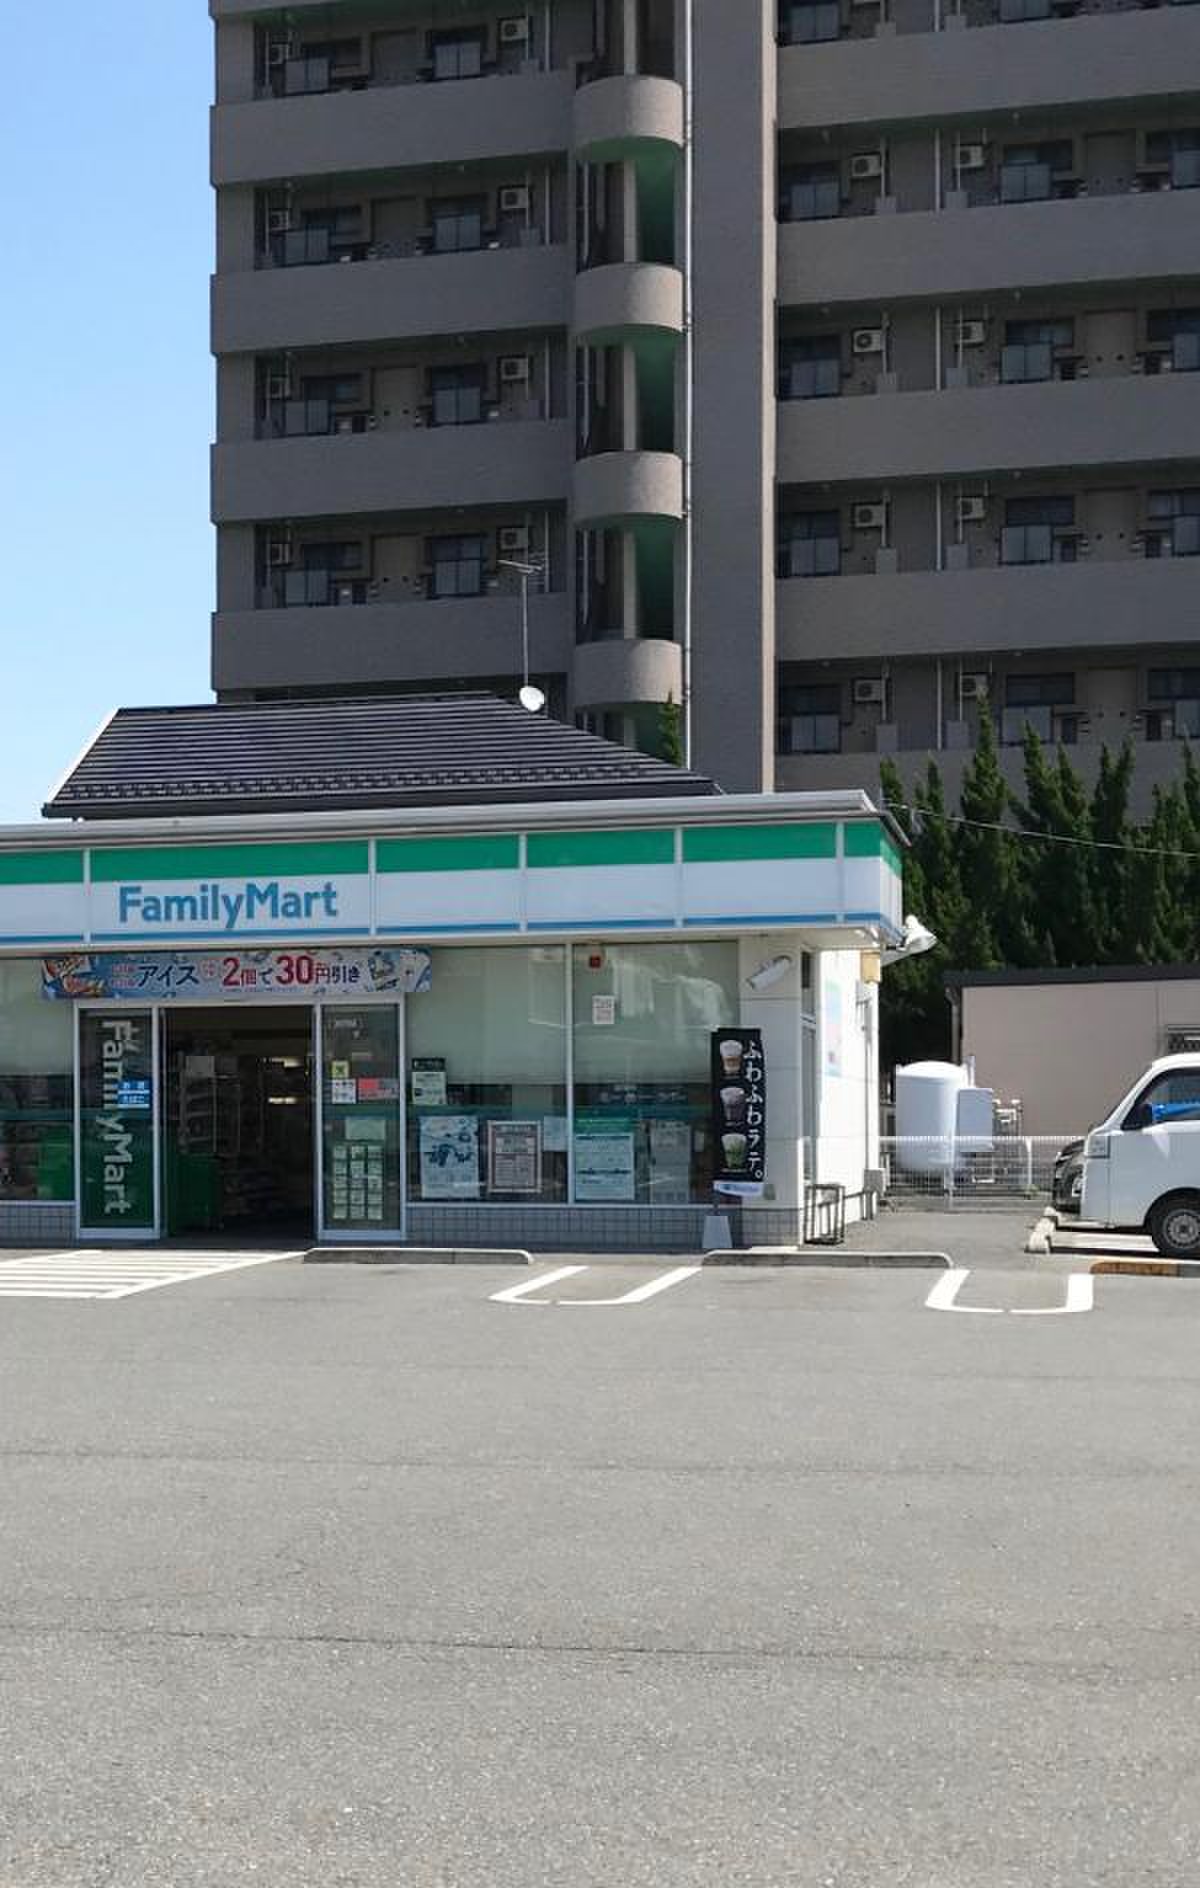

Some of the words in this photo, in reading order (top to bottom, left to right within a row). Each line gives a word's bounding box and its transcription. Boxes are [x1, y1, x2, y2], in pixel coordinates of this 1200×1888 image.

[119, 882, 338, 929] FamilyMart
[138, 964, 199, 987] アイス
[222, 954, 361, 988] 2個で30円引き
